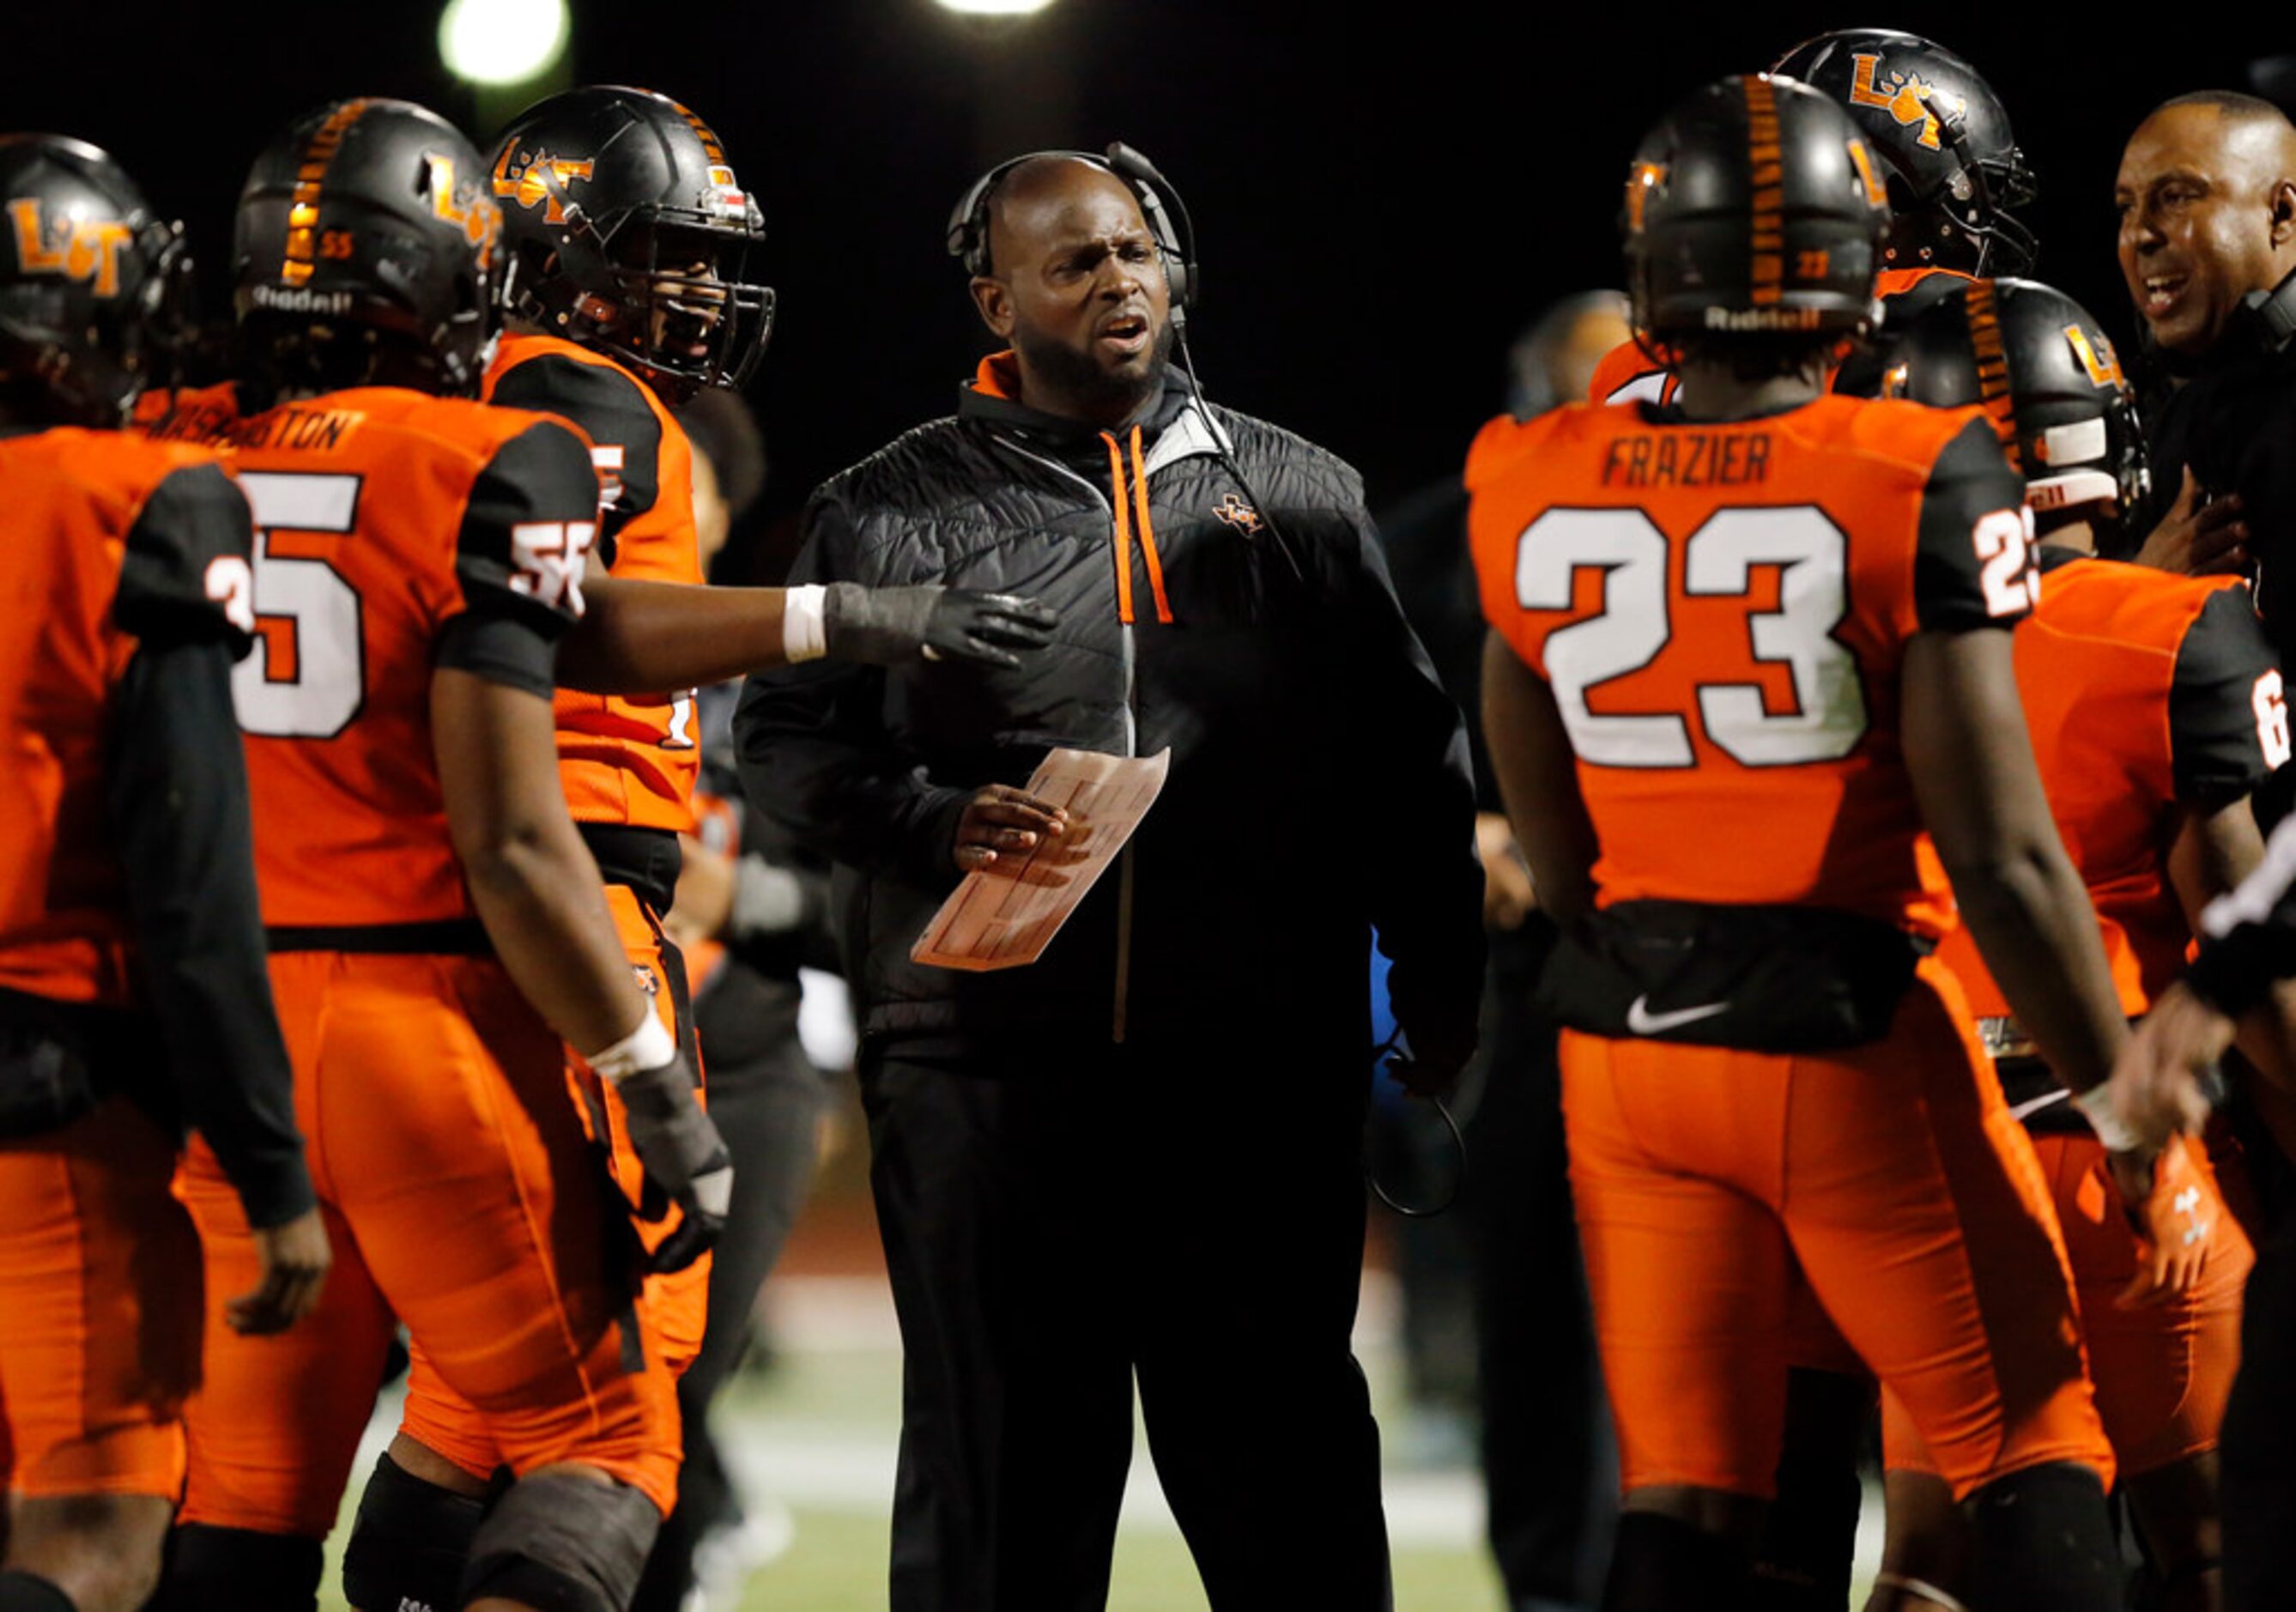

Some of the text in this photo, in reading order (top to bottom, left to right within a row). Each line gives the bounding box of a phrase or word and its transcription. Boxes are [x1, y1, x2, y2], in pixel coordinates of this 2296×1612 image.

[1602, 433, 1772, 487] FRAZIER
[1514, 504, 1869, 767] 23
[2251, 669, 2292, 772] 6
